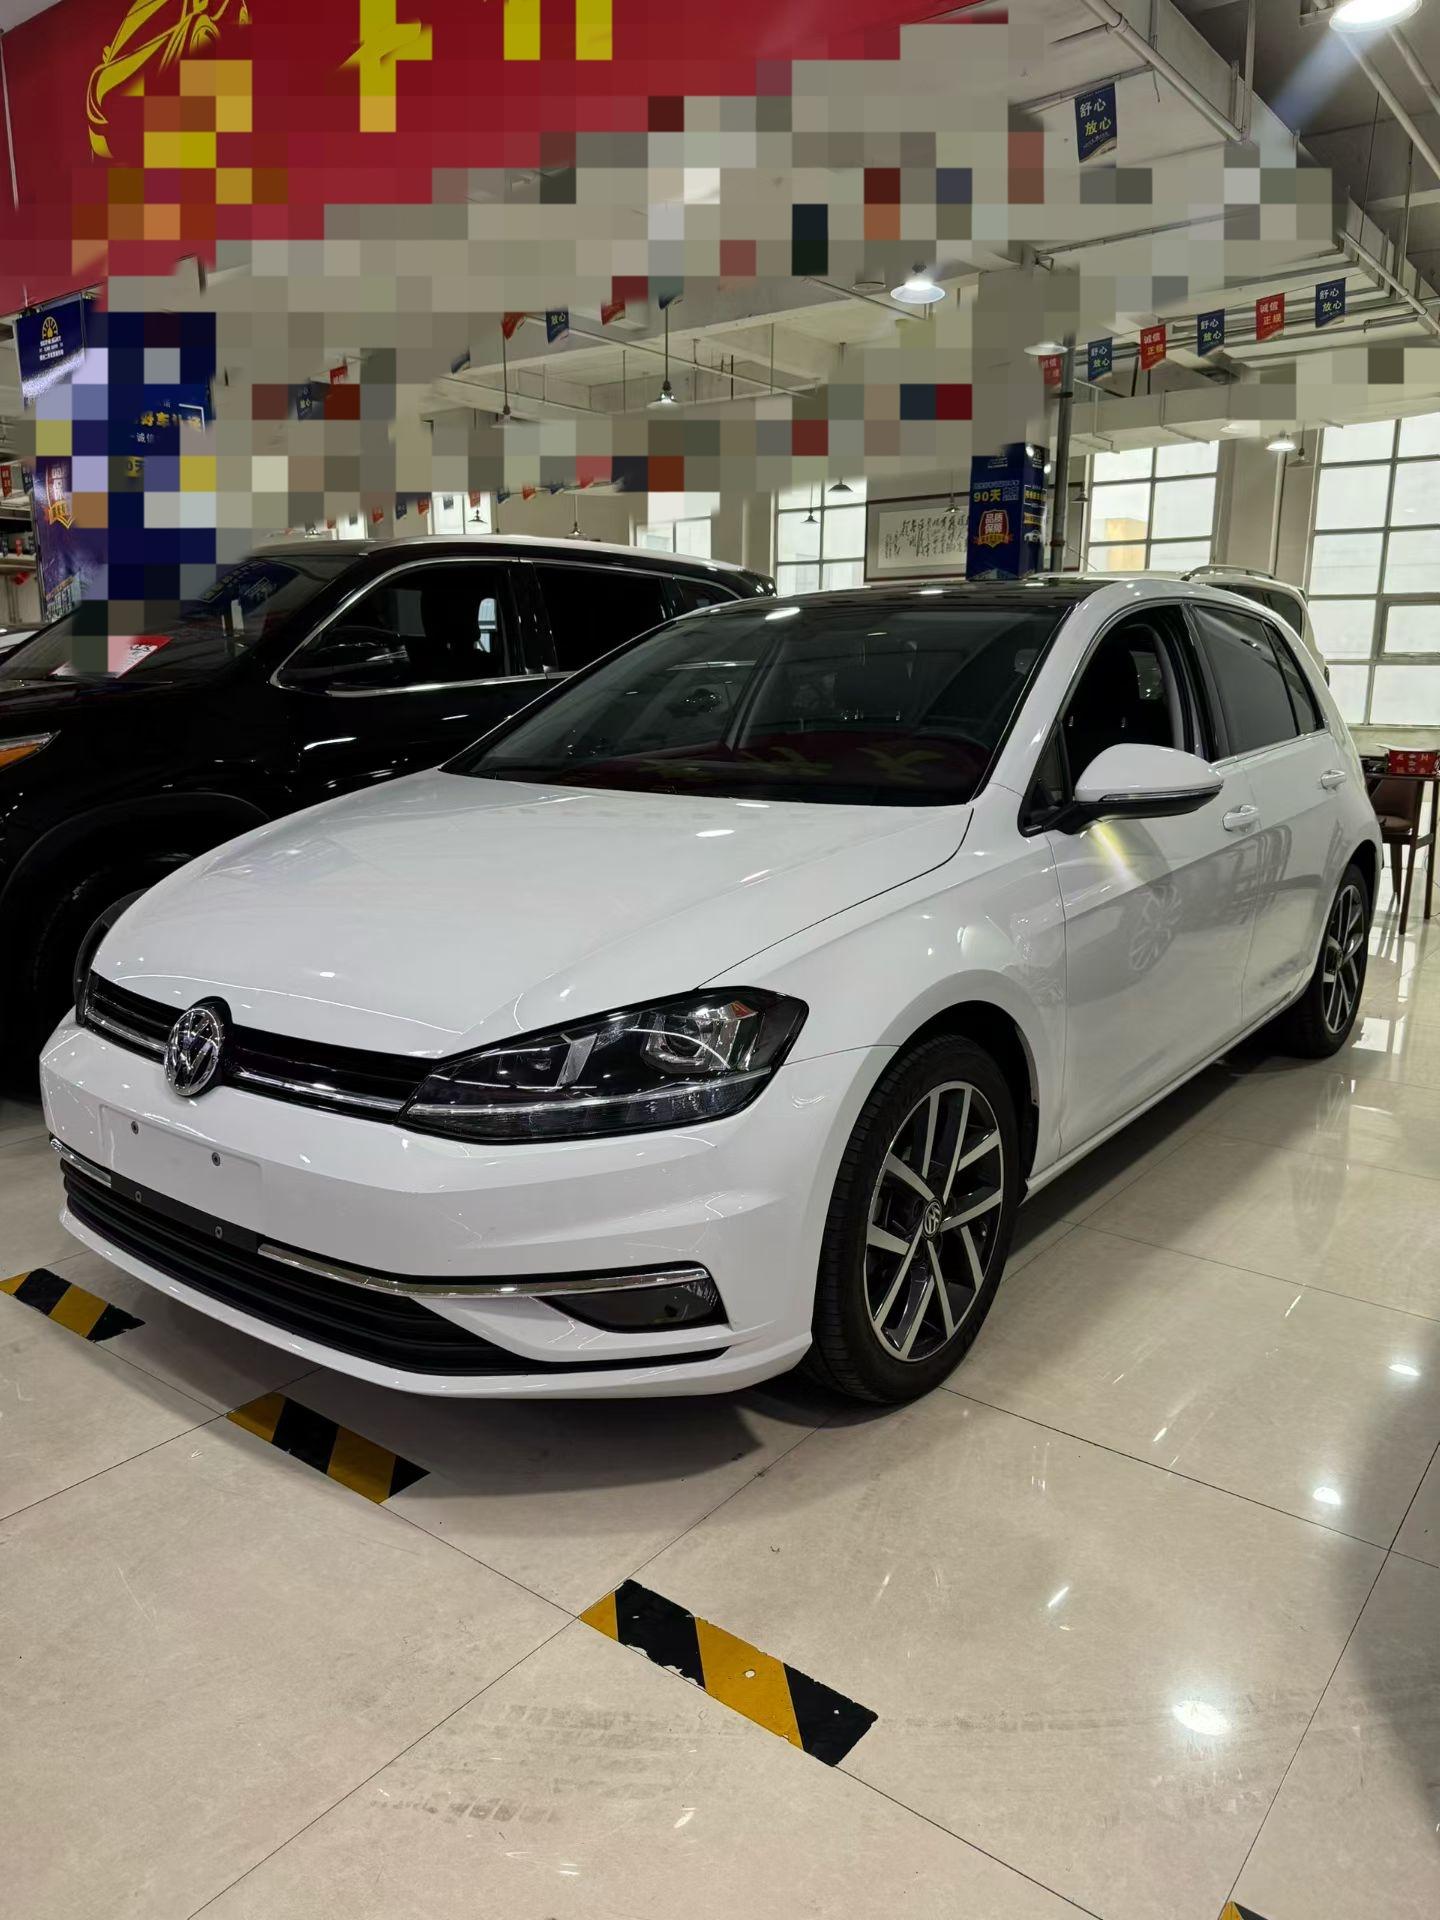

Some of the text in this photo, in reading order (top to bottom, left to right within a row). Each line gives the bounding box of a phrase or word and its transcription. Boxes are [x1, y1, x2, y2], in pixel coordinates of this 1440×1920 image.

[1080, 98, 1106, 118] 舒心
[1085, 117, 1111, 136] 放心
[1320, 288, 1339, 299] 舒心
[1323, 301, 1341, 312] 放心
[1201, 319, 1218, 329] 舒心
[974, 488, 1001, 502] 90天
